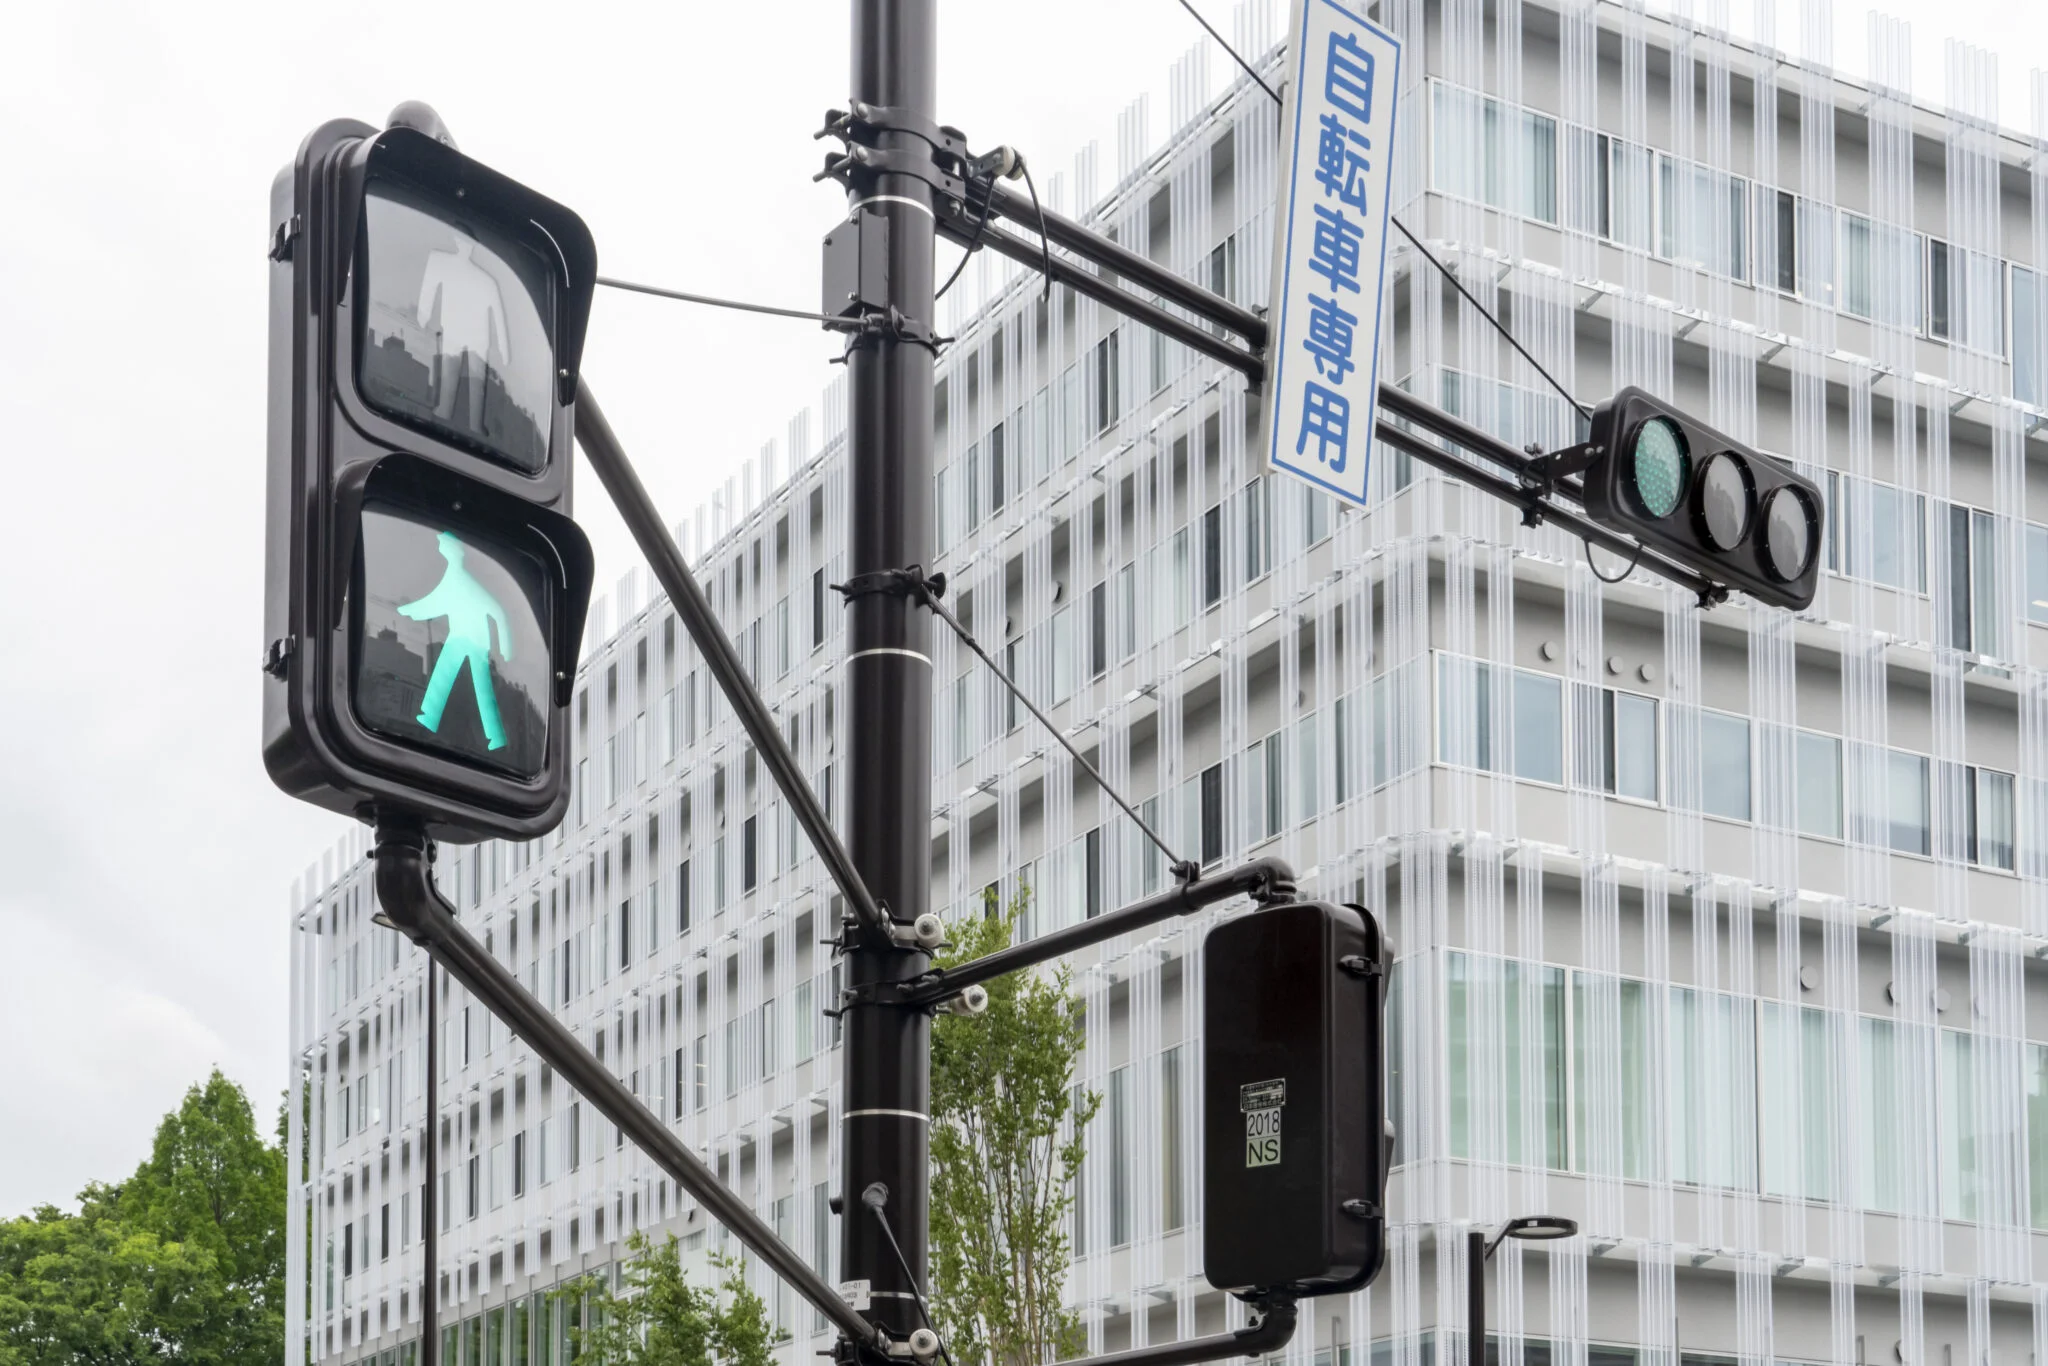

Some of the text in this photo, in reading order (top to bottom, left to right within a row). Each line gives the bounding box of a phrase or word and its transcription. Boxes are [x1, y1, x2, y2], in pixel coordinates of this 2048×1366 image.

[1296, 31, 1376, 474] 自転車専用
[1248, 1110, 1280, 1136] 2018
[1248, 1139, 1279, 1165] NS
